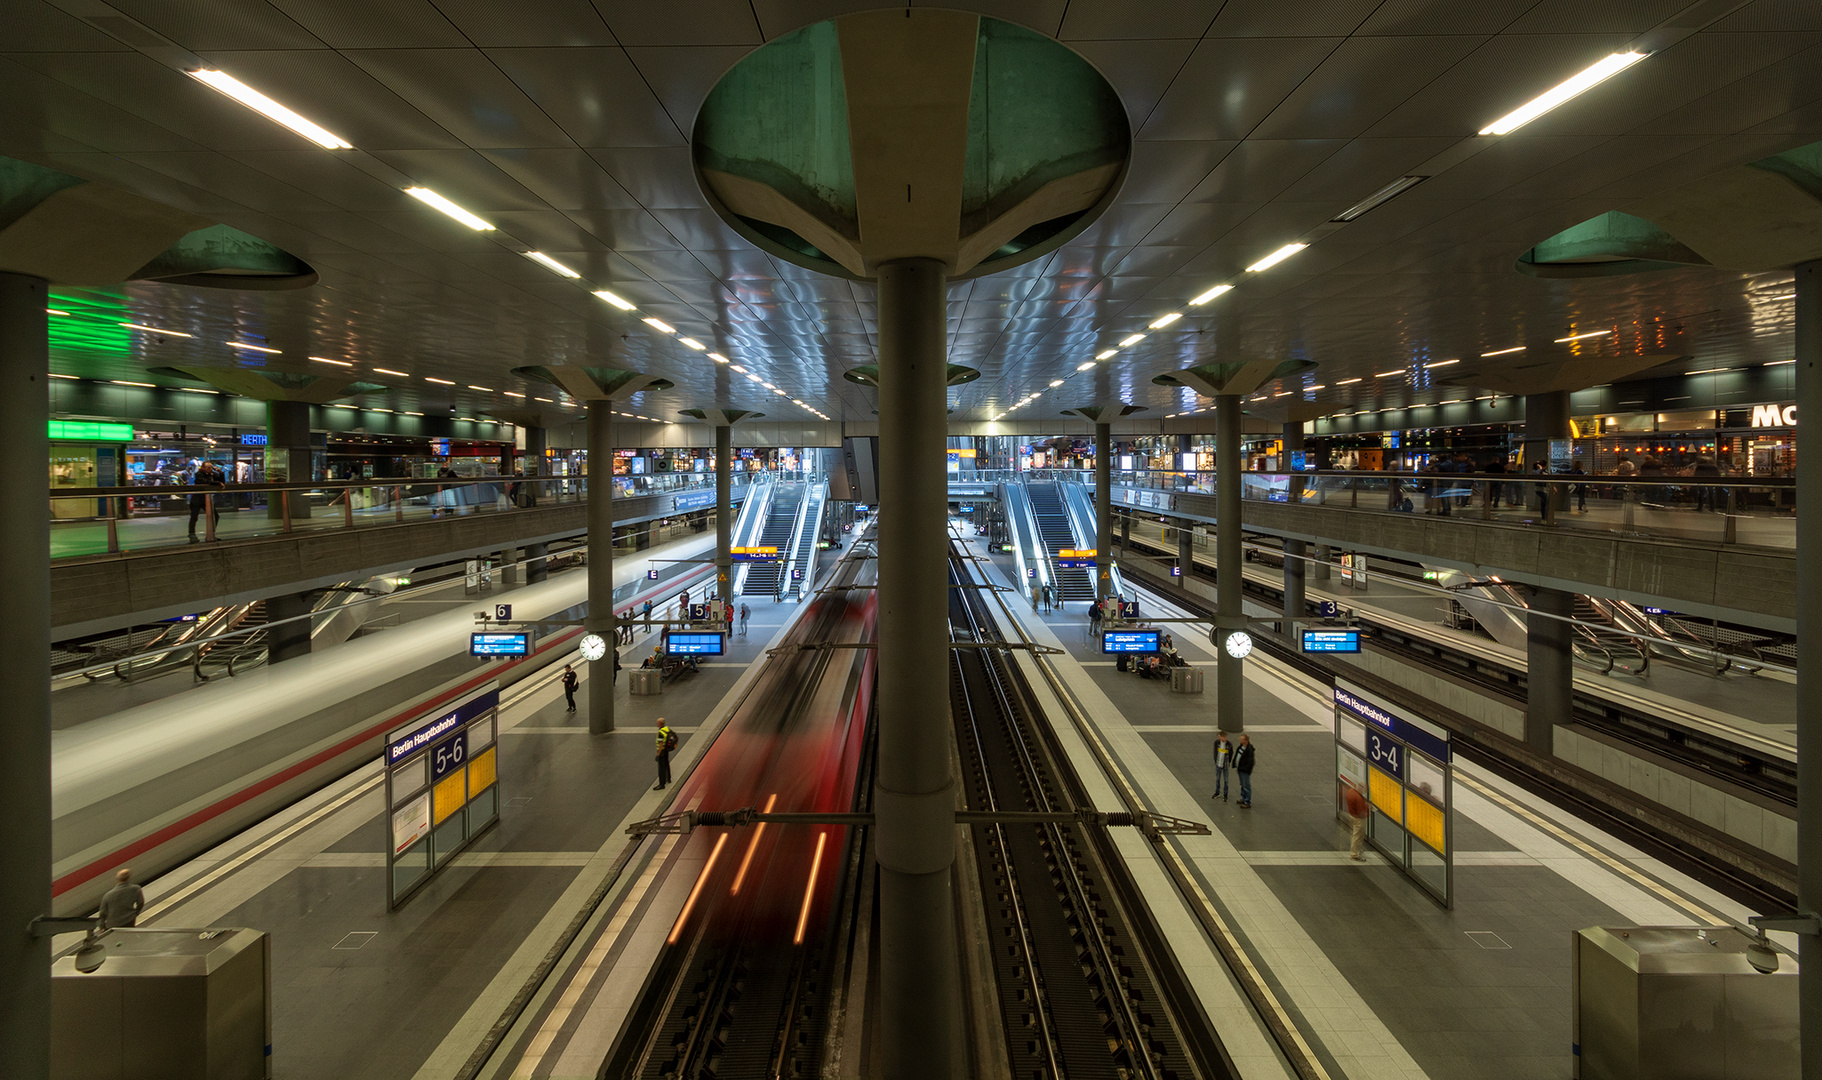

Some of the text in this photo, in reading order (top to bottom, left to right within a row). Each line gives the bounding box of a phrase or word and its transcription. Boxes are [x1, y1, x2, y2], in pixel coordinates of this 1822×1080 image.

[241, 434, 268, 445] HERTH
[650, 570, 657, 579] E
[793, 569, 800, 578] E
[1027, 568, 1034, 577] E
[1174, 567, 1181, 576] E
[497, 604, 506, 617] 6
[695, 604, 704, 617] 5
[1125, 602, 1134, 615] 4
[1327, 601, 1336, 614] 3
[1335, 690, 1391, 727] Berlin Hauptbahnhof
[392, 714, 457, 758] Berlin Hauptbahnhof
[436, 737, 463, 774] 5-6
[1371, 735, 1398, 772] 3-4
